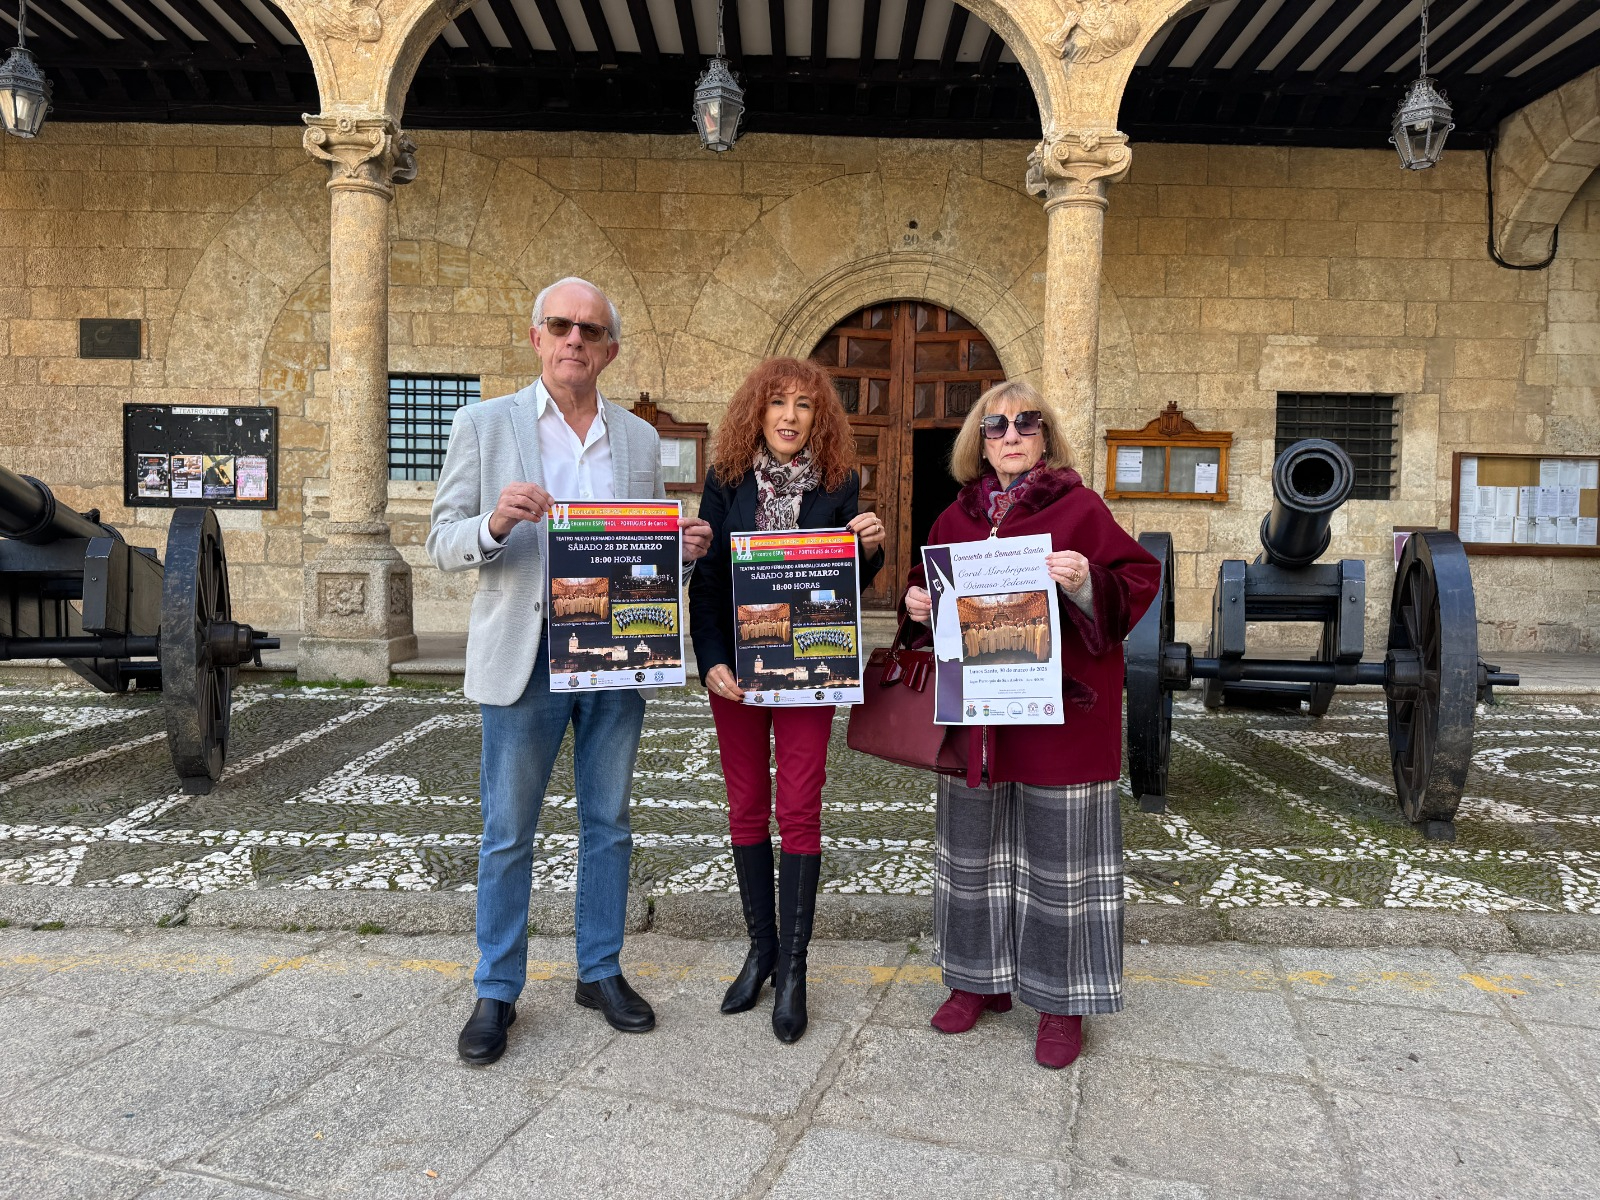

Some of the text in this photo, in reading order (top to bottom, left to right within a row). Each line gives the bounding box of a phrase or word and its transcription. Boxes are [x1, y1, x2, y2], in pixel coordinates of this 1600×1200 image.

[903, 233, 920, 246] 20
[551, 504, 570, 524] VI
[568, 543, 603, 551] SÁBADO
[604, 543, 614, 551] 28
[733, 536, 752, 556] VI
[590, 556, 612, 564] 18:00
[953, 546, 1045, 562] Concierto de Semana Santa
[751, 572, 783, 580] SÁBADO
[784, 570, 794, 578] 28
[808, 569, 840, 577] MARZO
[958, 565, 1041, 578] Coral Mirobrigense
[772, 582, 821, 591] 18:00 HORAS
[963, 577, 1038, 590] Dámaso Ledesma
